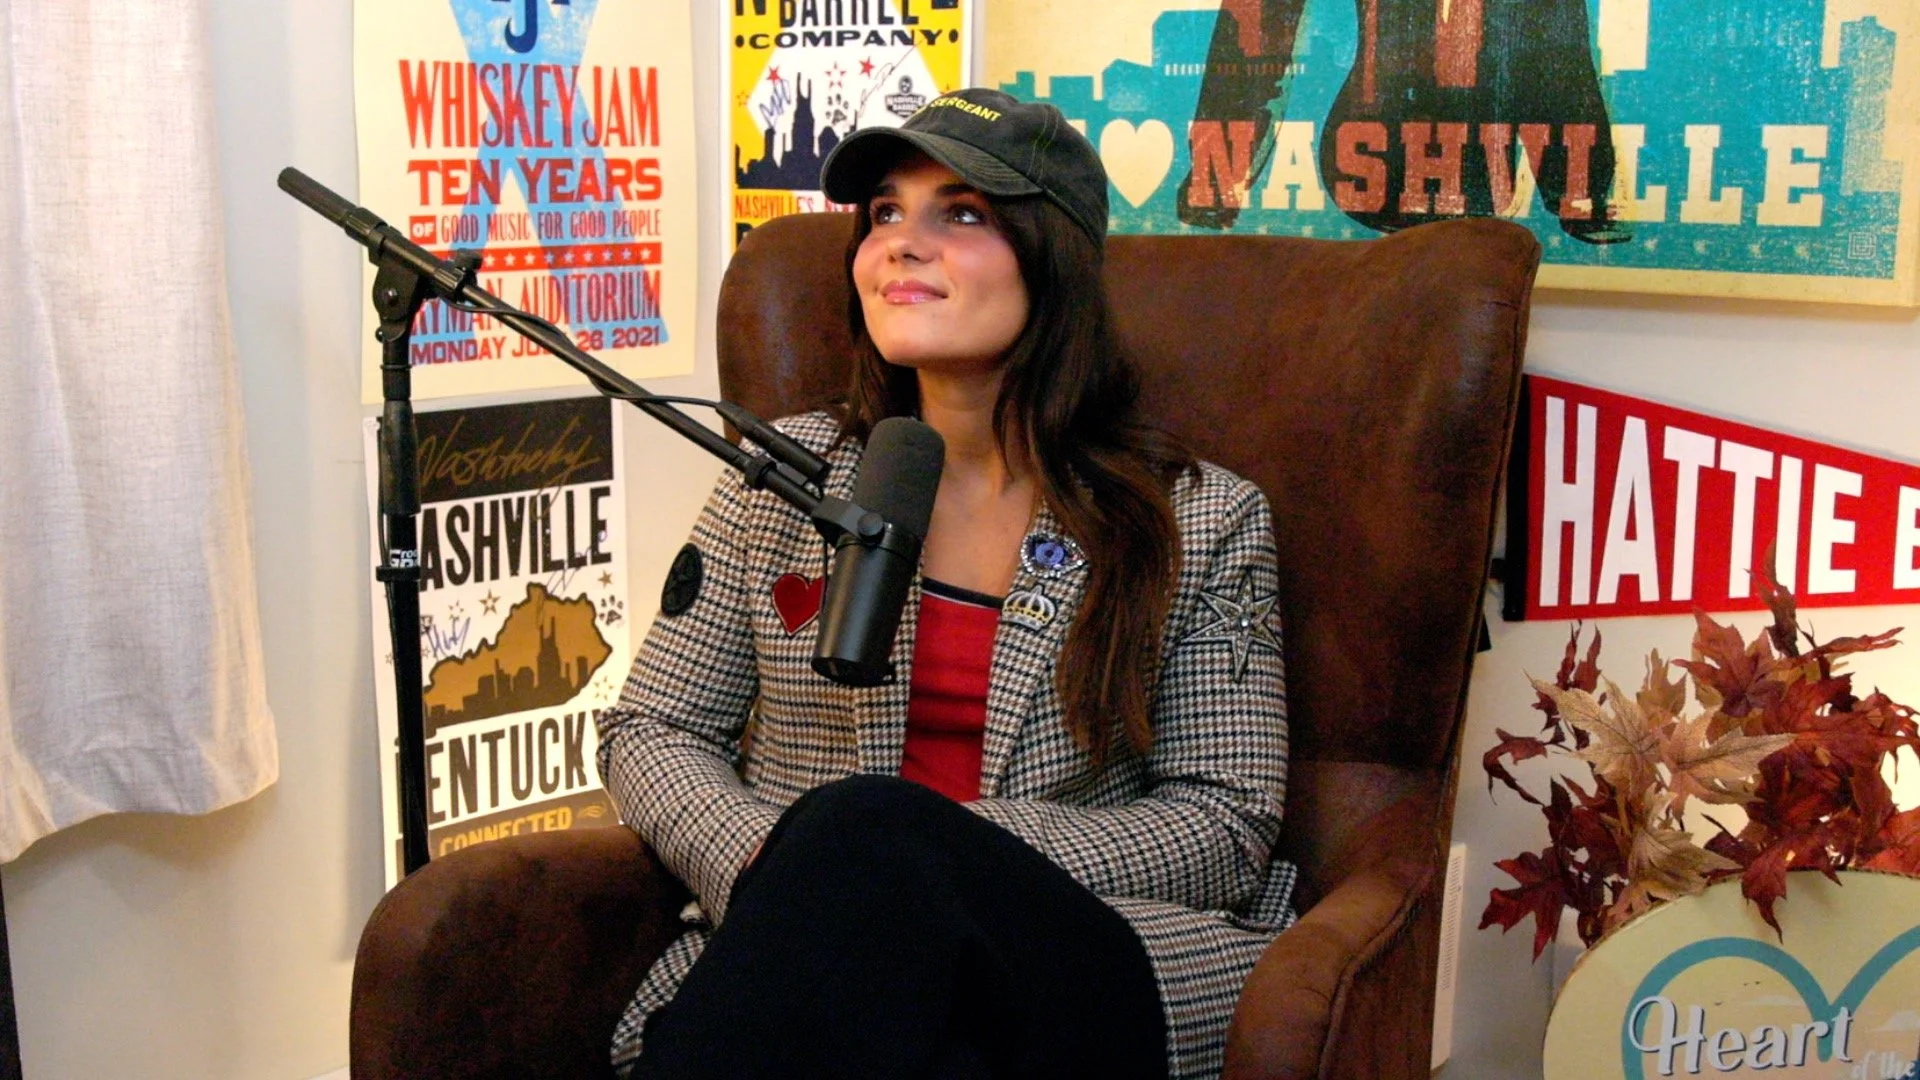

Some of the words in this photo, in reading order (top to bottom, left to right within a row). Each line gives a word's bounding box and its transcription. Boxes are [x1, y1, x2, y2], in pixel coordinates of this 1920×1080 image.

[750, 29, 943, 49] COMPANY
[399, 60, 579, 148] WHISKEY
[583, 66, 660, 147] JAM
[407, 159, 500, 206] TEN
[516, 158, 662, 203] YEARS
[1187, 119, 1829, 227] NASHVILLE
[411, 222, 435, 238] OF
[441, 213, 479, 243] GOOD
[486, 211, 532, 242] MUSIC
[538, 210, 565, 240] FOR
[570, 210, 606, 239] GOOD
[612, 208, 662, 238] PEOPLE
[520, 270, 661, 325] AUDITORIUM
[411, 336, 507, 367] MONDAY
[576, 329, 603, 352] 26
[612, 325, 661, 348] 2021
[1539, 395, 1863, 608] HATTIE
[419, 486, 612, 592] ASHVILLE
[439, 806, 573, 857] CONNECTED
[1628, 995, 1854, 1076] Heart
